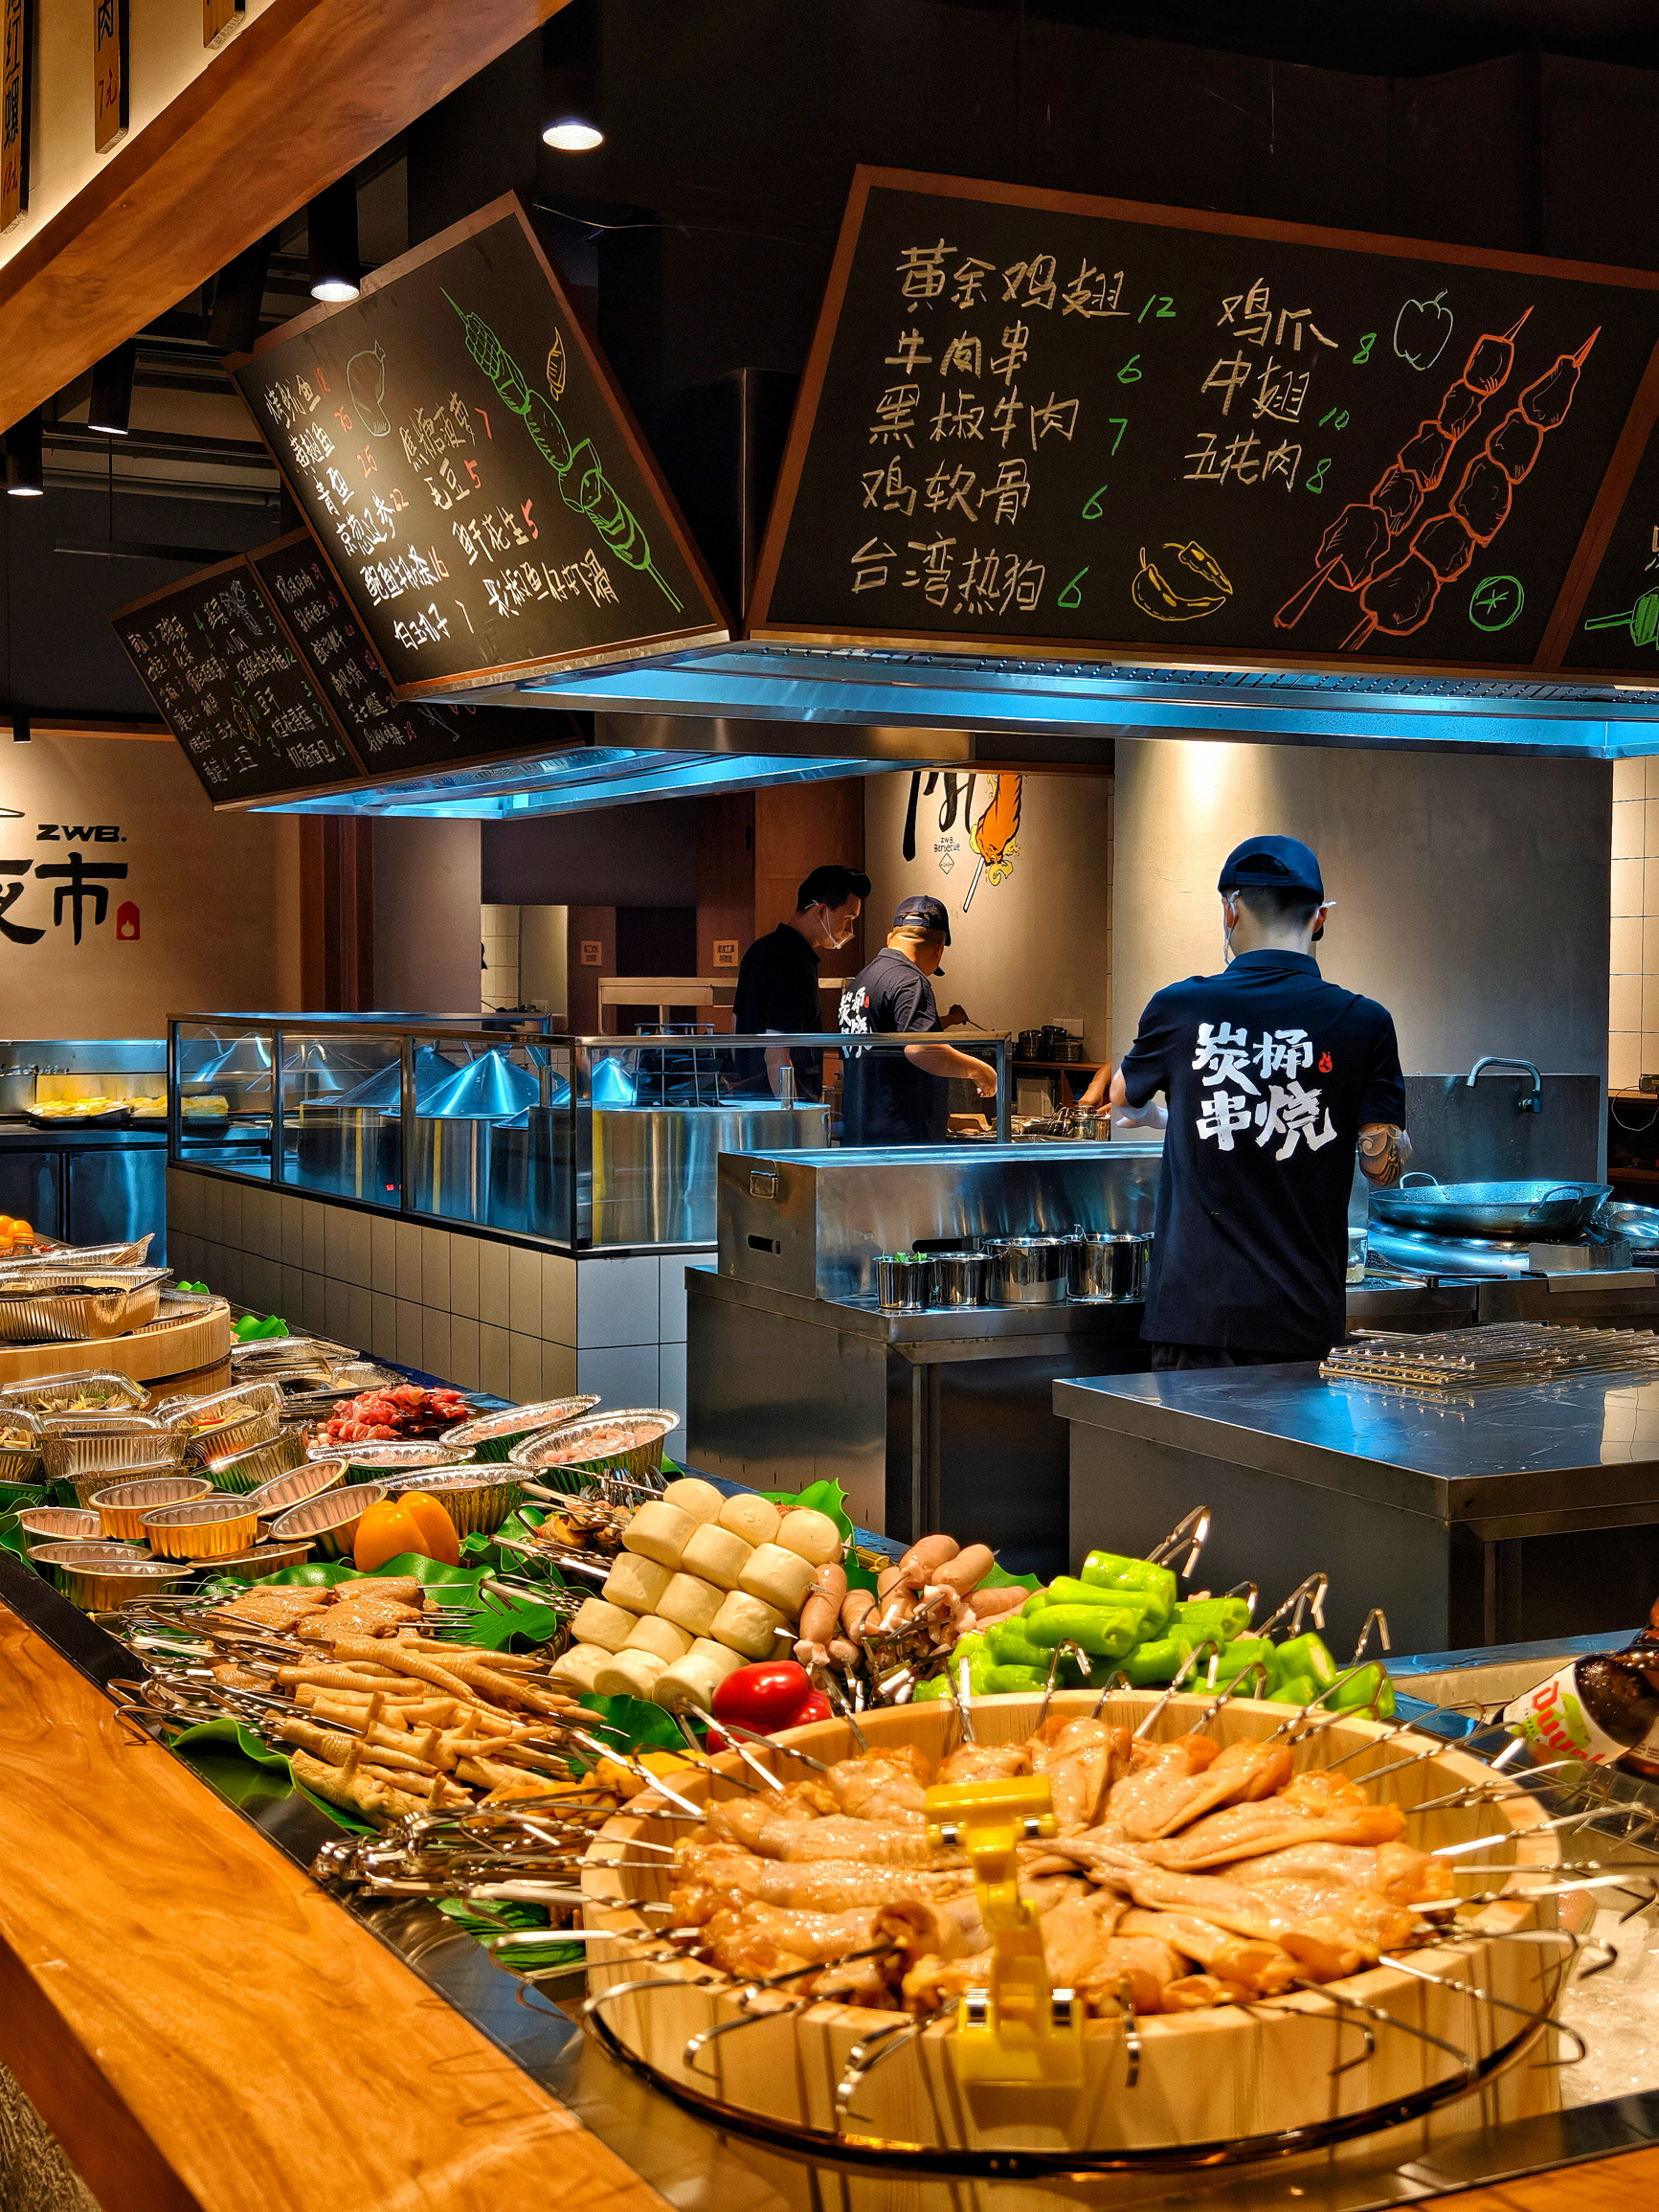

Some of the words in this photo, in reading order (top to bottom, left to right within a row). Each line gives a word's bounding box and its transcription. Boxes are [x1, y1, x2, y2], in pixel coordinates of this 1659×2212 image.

[896, 238, 1131, 318] 黄金鸡翅
[1137, 294, 1177, 323] 12
[885, 320, 1030, 385] 牛肉串
[1117, 354, 1142, 384] 6
[1217, 278, 1338, 351] 鸡爪
[1352, 332, 1377, 364] 8
[264, 375, 321, 429] 烤鱿鱼
[868, 383, 1079, 451] 黑椒牛肉
[1108, 418, 1129, 456] 7
[1200, 350, 1310, 423] 中翅
[1318, 407, 1350, 429] 10
[398, 392, 476, 471] 焦糖菠萝
[474, 407, 493, 439] 7
[1182, 430, 1302, 492] 五花肉
[1306, 458, 1332, 494] 8
[314, 467, 354, 516] 青鱼
[357, 445, 378, 478] 25
[390, 488, 409, 511] 22
[424, 458, 470, 509] 毛豆
[463, 460, 481, 488] 5
[861, 454, 1031, 526] 鸡软骨
[1082, 485, 1108, 520] 6
[429, 546, 450, 580] 16
[453, 506, 529, 566] 鲜花生
[521, 498, 538, 539] 5
[253, 590, 263, 608] 3
[851, 530, 1046, 616] 台湾热狗
[1057, 565, 1090, 607] 6
[265, 616, 276, 633] 3
[393, 602, 450, 650] 白玉丸子
[455, 599, 475, 634] 7
[301, 681, 312, 697] 3
[313, 704, 328, 726] 8
[267, 736, 280, 756] 3
[335, 740, 346, 756] 6
[36, 824, 126, 842] ZWB.
[1192, 1022, 1313, 1095] 炭桶
[1196, 1080, 1337, 1162] 串烧
